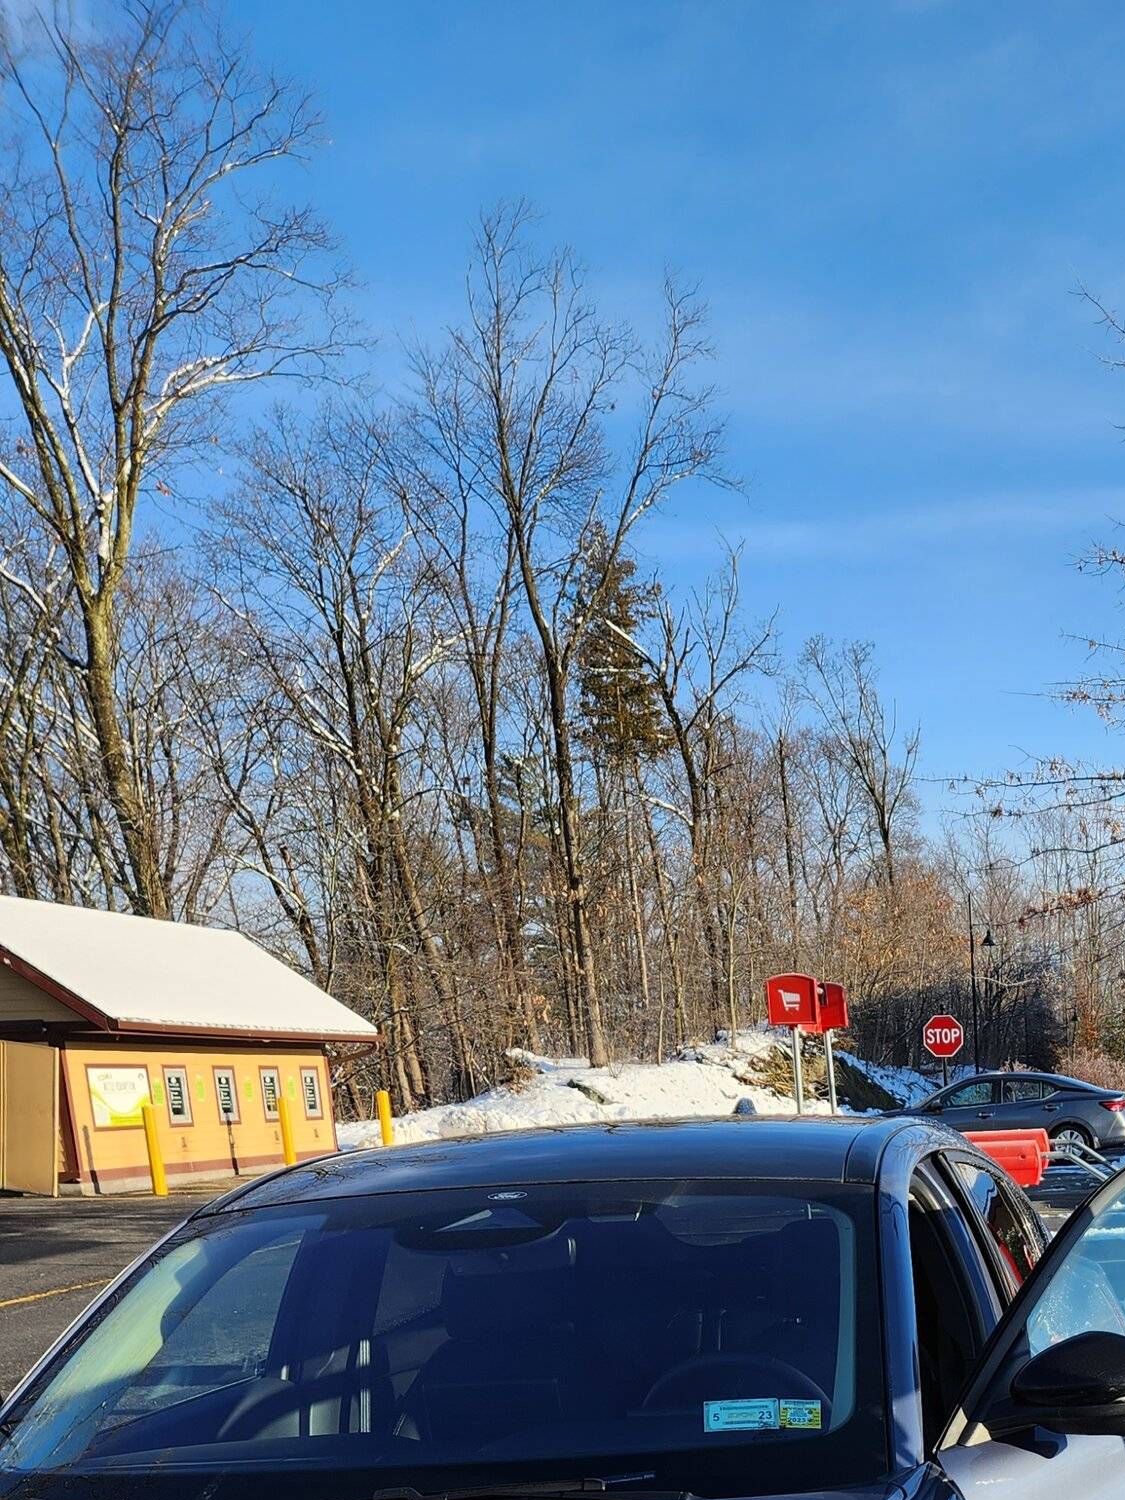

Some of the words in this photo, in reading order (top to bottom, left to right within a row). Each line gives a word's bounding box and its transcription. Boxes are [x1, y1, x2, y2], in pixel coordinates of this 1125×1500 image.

[926, 1028, 960, 1044] STOP
[712, 1412, 720, 1422] 5
[759, 1411, 772, 1420] 23
